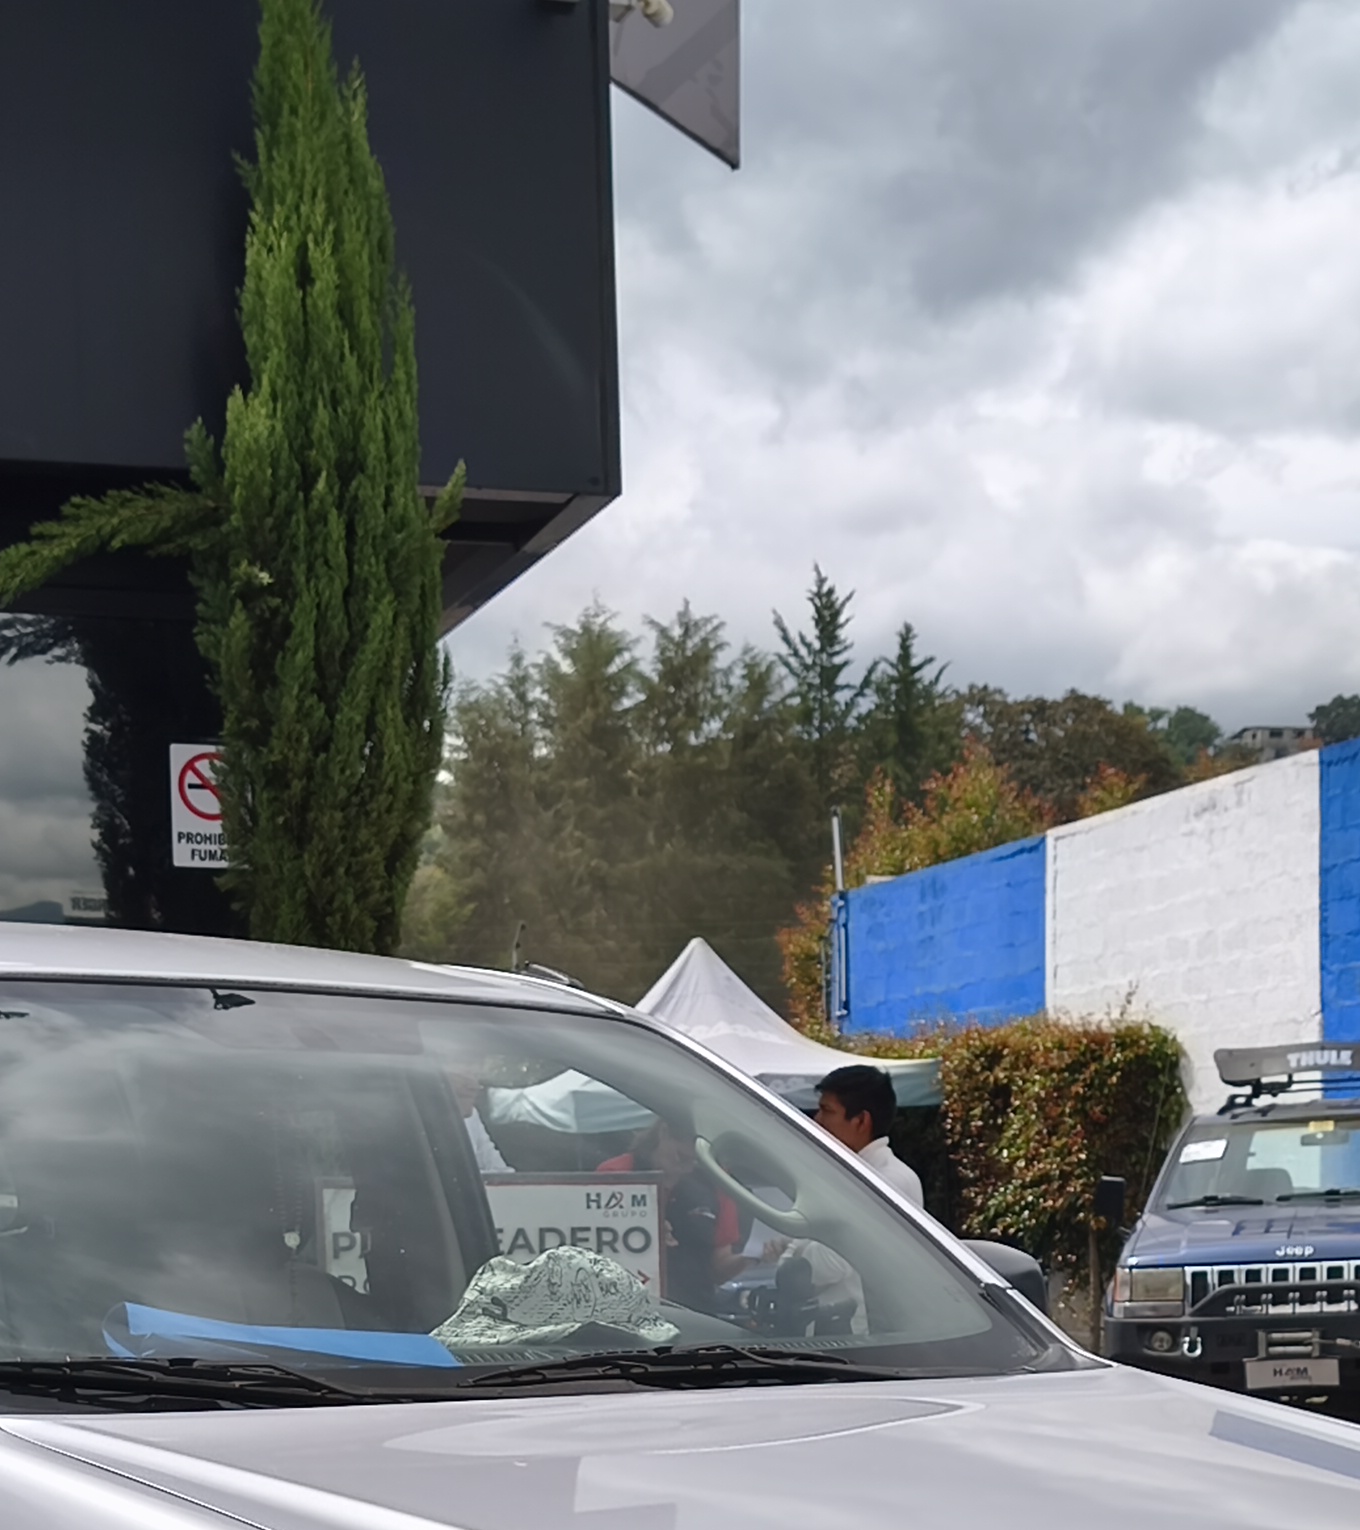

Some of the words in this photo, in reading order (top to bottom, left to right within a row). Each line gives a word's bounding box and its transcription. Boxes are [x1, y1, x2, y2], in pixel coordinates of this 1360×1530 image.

[177, 831, 227, 846] PROHIB
[191, 848, 228, 862] FUMA
[1286, 1050, 1353, 1068] THULE
[1275, 1244, 1315, 1257] Jeep
